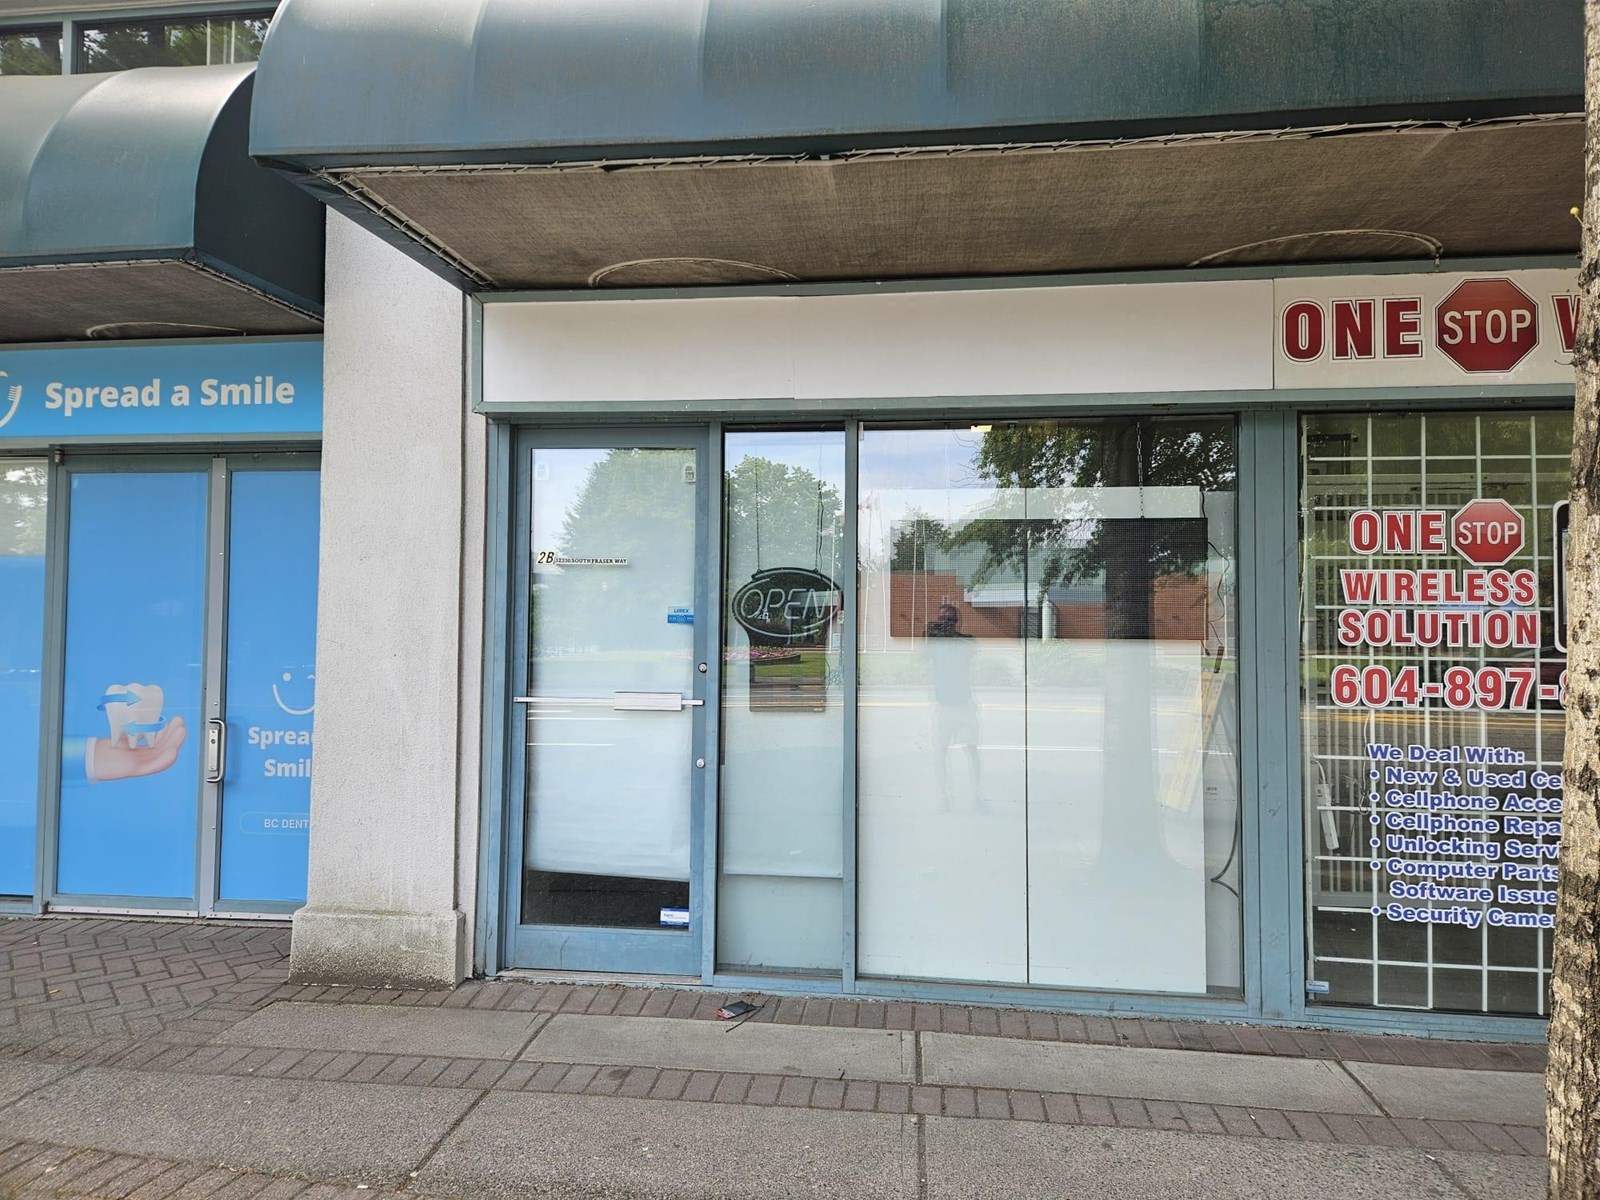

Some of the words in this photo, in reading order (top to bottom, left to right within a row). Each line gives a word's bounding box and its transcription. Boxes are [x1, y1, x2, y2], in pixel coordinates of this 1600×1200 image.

[1283, 298, 1423, 362] ONE
[1443, 309, 1532, 344] STOP
[45, 378, 161, 417] Spread
[170, 385, 190, 407] a
[200, 376, 295, 406] Smile
[1350, 511, 1446, 554] ONE
[1458, 521, 1518, 544] STOP
[1340, 569, 1536, 606] WIRELESS
[740, 588, 831, 619] OPEN
[1338, 609, 1541, 648] SOLUTION
[248, 726, 314, 749] Sprea
[1367, 744, 1402, 761] We
[1408, 745, 1459, 762] Deal
[1464, 746, 1525, 764] With:
[1385, 767, 1437, 785] New
[1443, 769, 1462, 787] &
[1467, 770, 1526, 788] Used
[1385, 790, 1500, 811] Cellphone
[264, 819, 279, 829] BC
[1385, 813, 1500, 834] Cellphone
[1386, 836, 1501, 859] Unlocking
[1387, 859, 1497, 880] Computer
[1390, 881, 1493, 902] Software
[1387, 904, 1482, 928] Security
